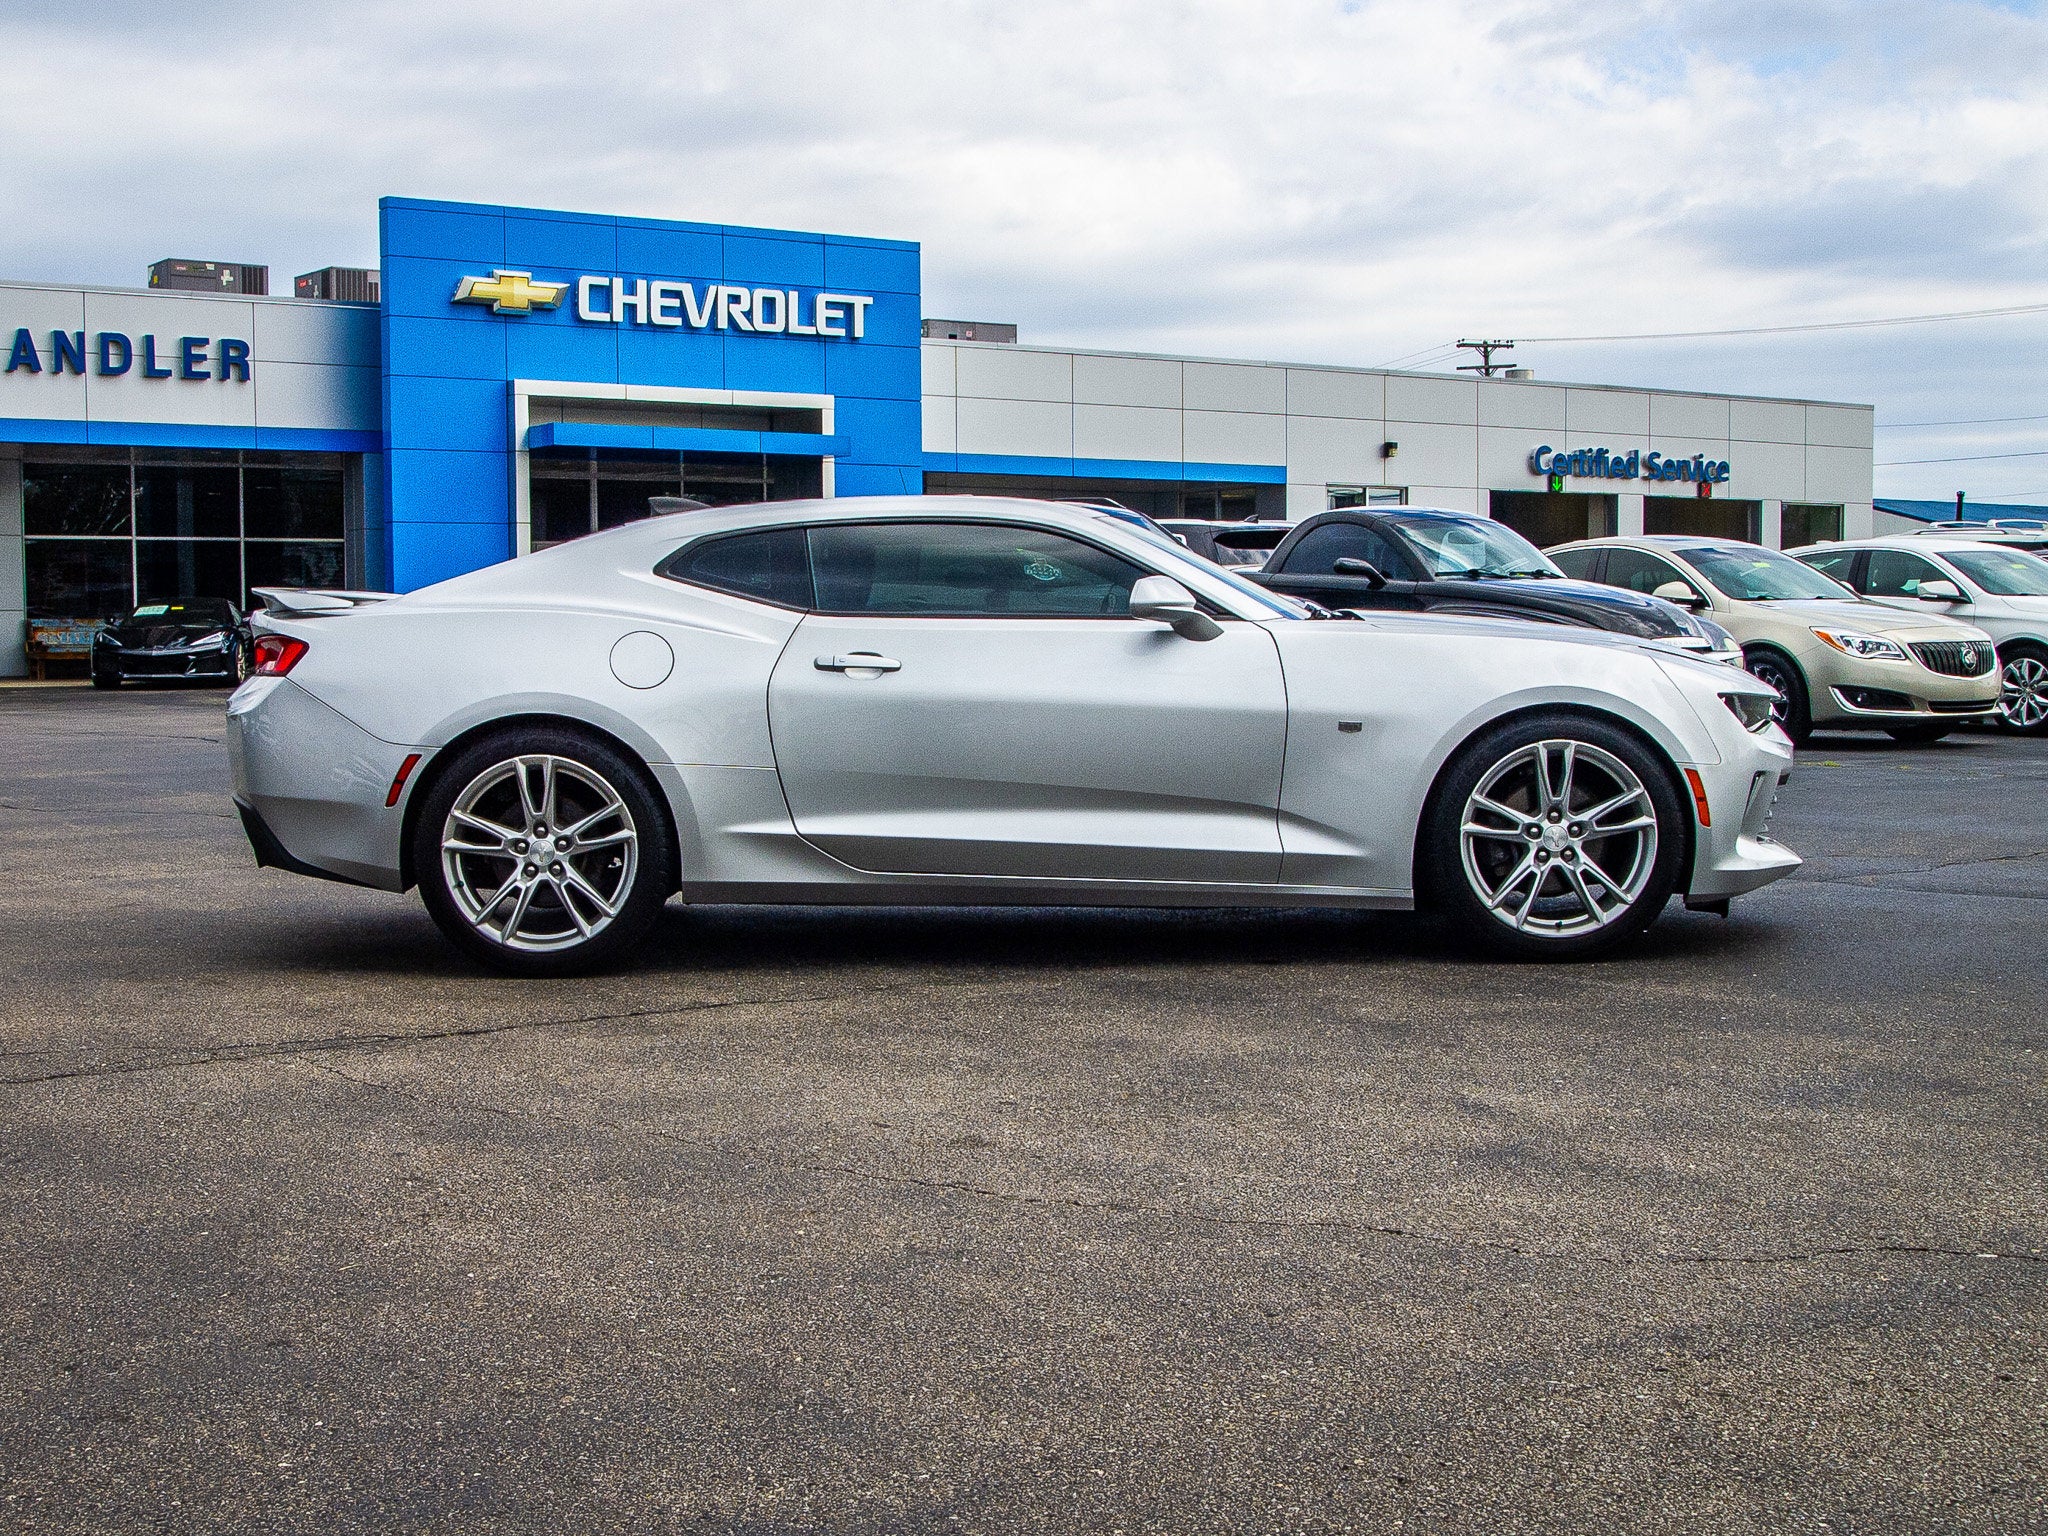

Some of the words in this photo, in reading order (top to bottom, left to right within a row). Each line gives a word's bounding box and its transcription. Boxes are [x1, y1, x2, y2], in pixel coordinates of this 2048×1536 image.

[577, 274, 874, 338] CHEVROLET
[5, 327, 251, 382] ANDLER
[1532, 445, 1640, 479] Certified
[1645, 451, 1731, 483] Service
